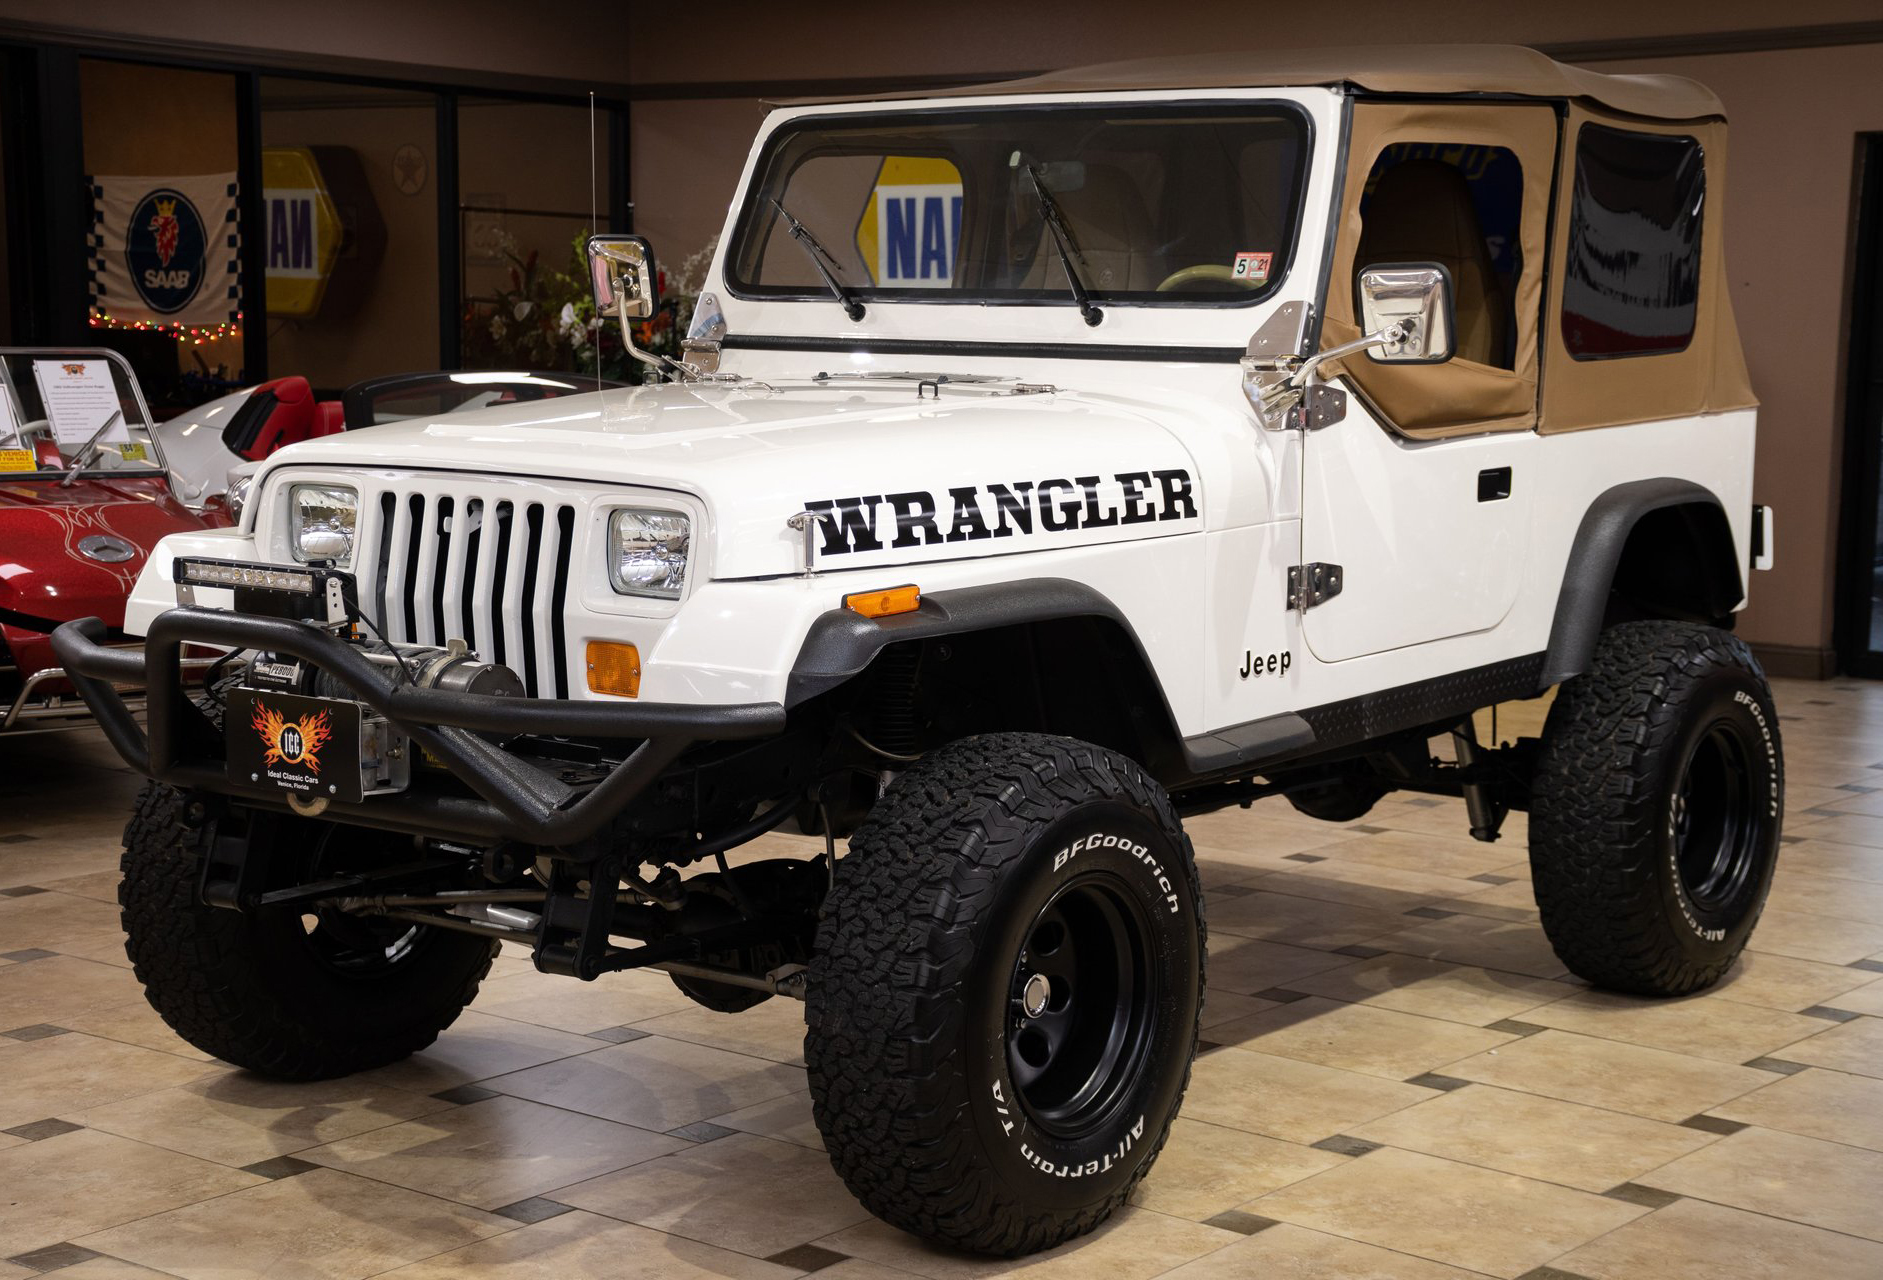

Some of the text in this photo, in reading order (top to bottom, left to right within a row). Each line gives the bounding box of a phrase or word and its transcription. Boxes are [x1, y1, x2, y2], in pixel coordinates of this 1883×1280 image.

[886, 196, 963, 279] NA
[144, 269, 191, 289] SAAB
[1237, 259, 1269, 274] 5 21
[804, 468, 1198, 556] WRANGLER
[1239, 650, 1291, 679] Jeep
[267, 770, 319, 784] Ideal Classic Cars
[1734, 690, 1779, 818] BFGoodrich
[277, 780, 294, 789] Venice,
[1053, 833, 1179, 913] BFGoodrich
[992, 1079, 1144, 1178] All-Terrain T/A
